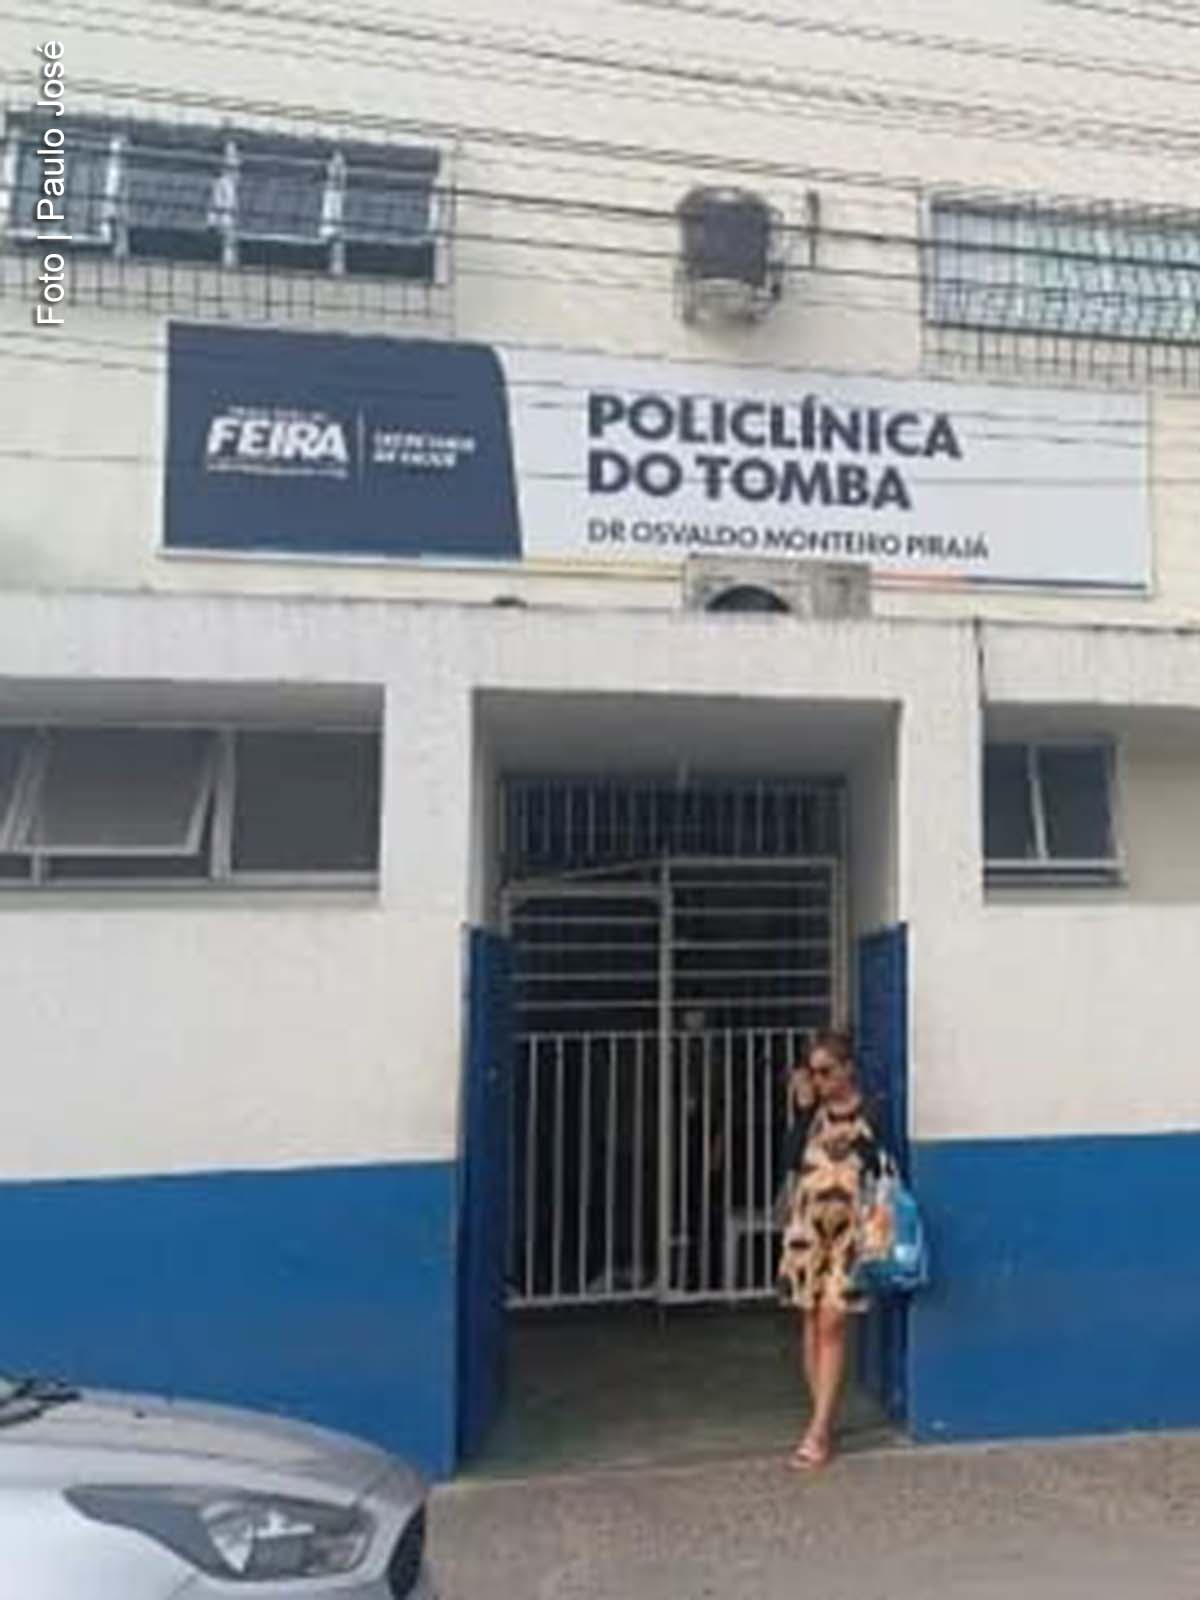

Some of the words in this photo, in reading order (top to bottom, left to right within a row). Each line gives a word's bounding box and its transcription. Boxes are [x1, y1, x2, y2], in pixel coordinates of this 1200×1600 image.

[206, 416, 348, 462] FEIRA
[587, 393, 962, 459] POLICLÍNICA
[587, 449, 684, 498] DO
[696, 456, 912, 510] TOMBA
[587, 518, 627, 544] DR
[631, 521, 760, 550] OSVALDO
[765, 527, 901, 557] MONTEIRO
[906, 532, 990, 560] PIRAJÁ
